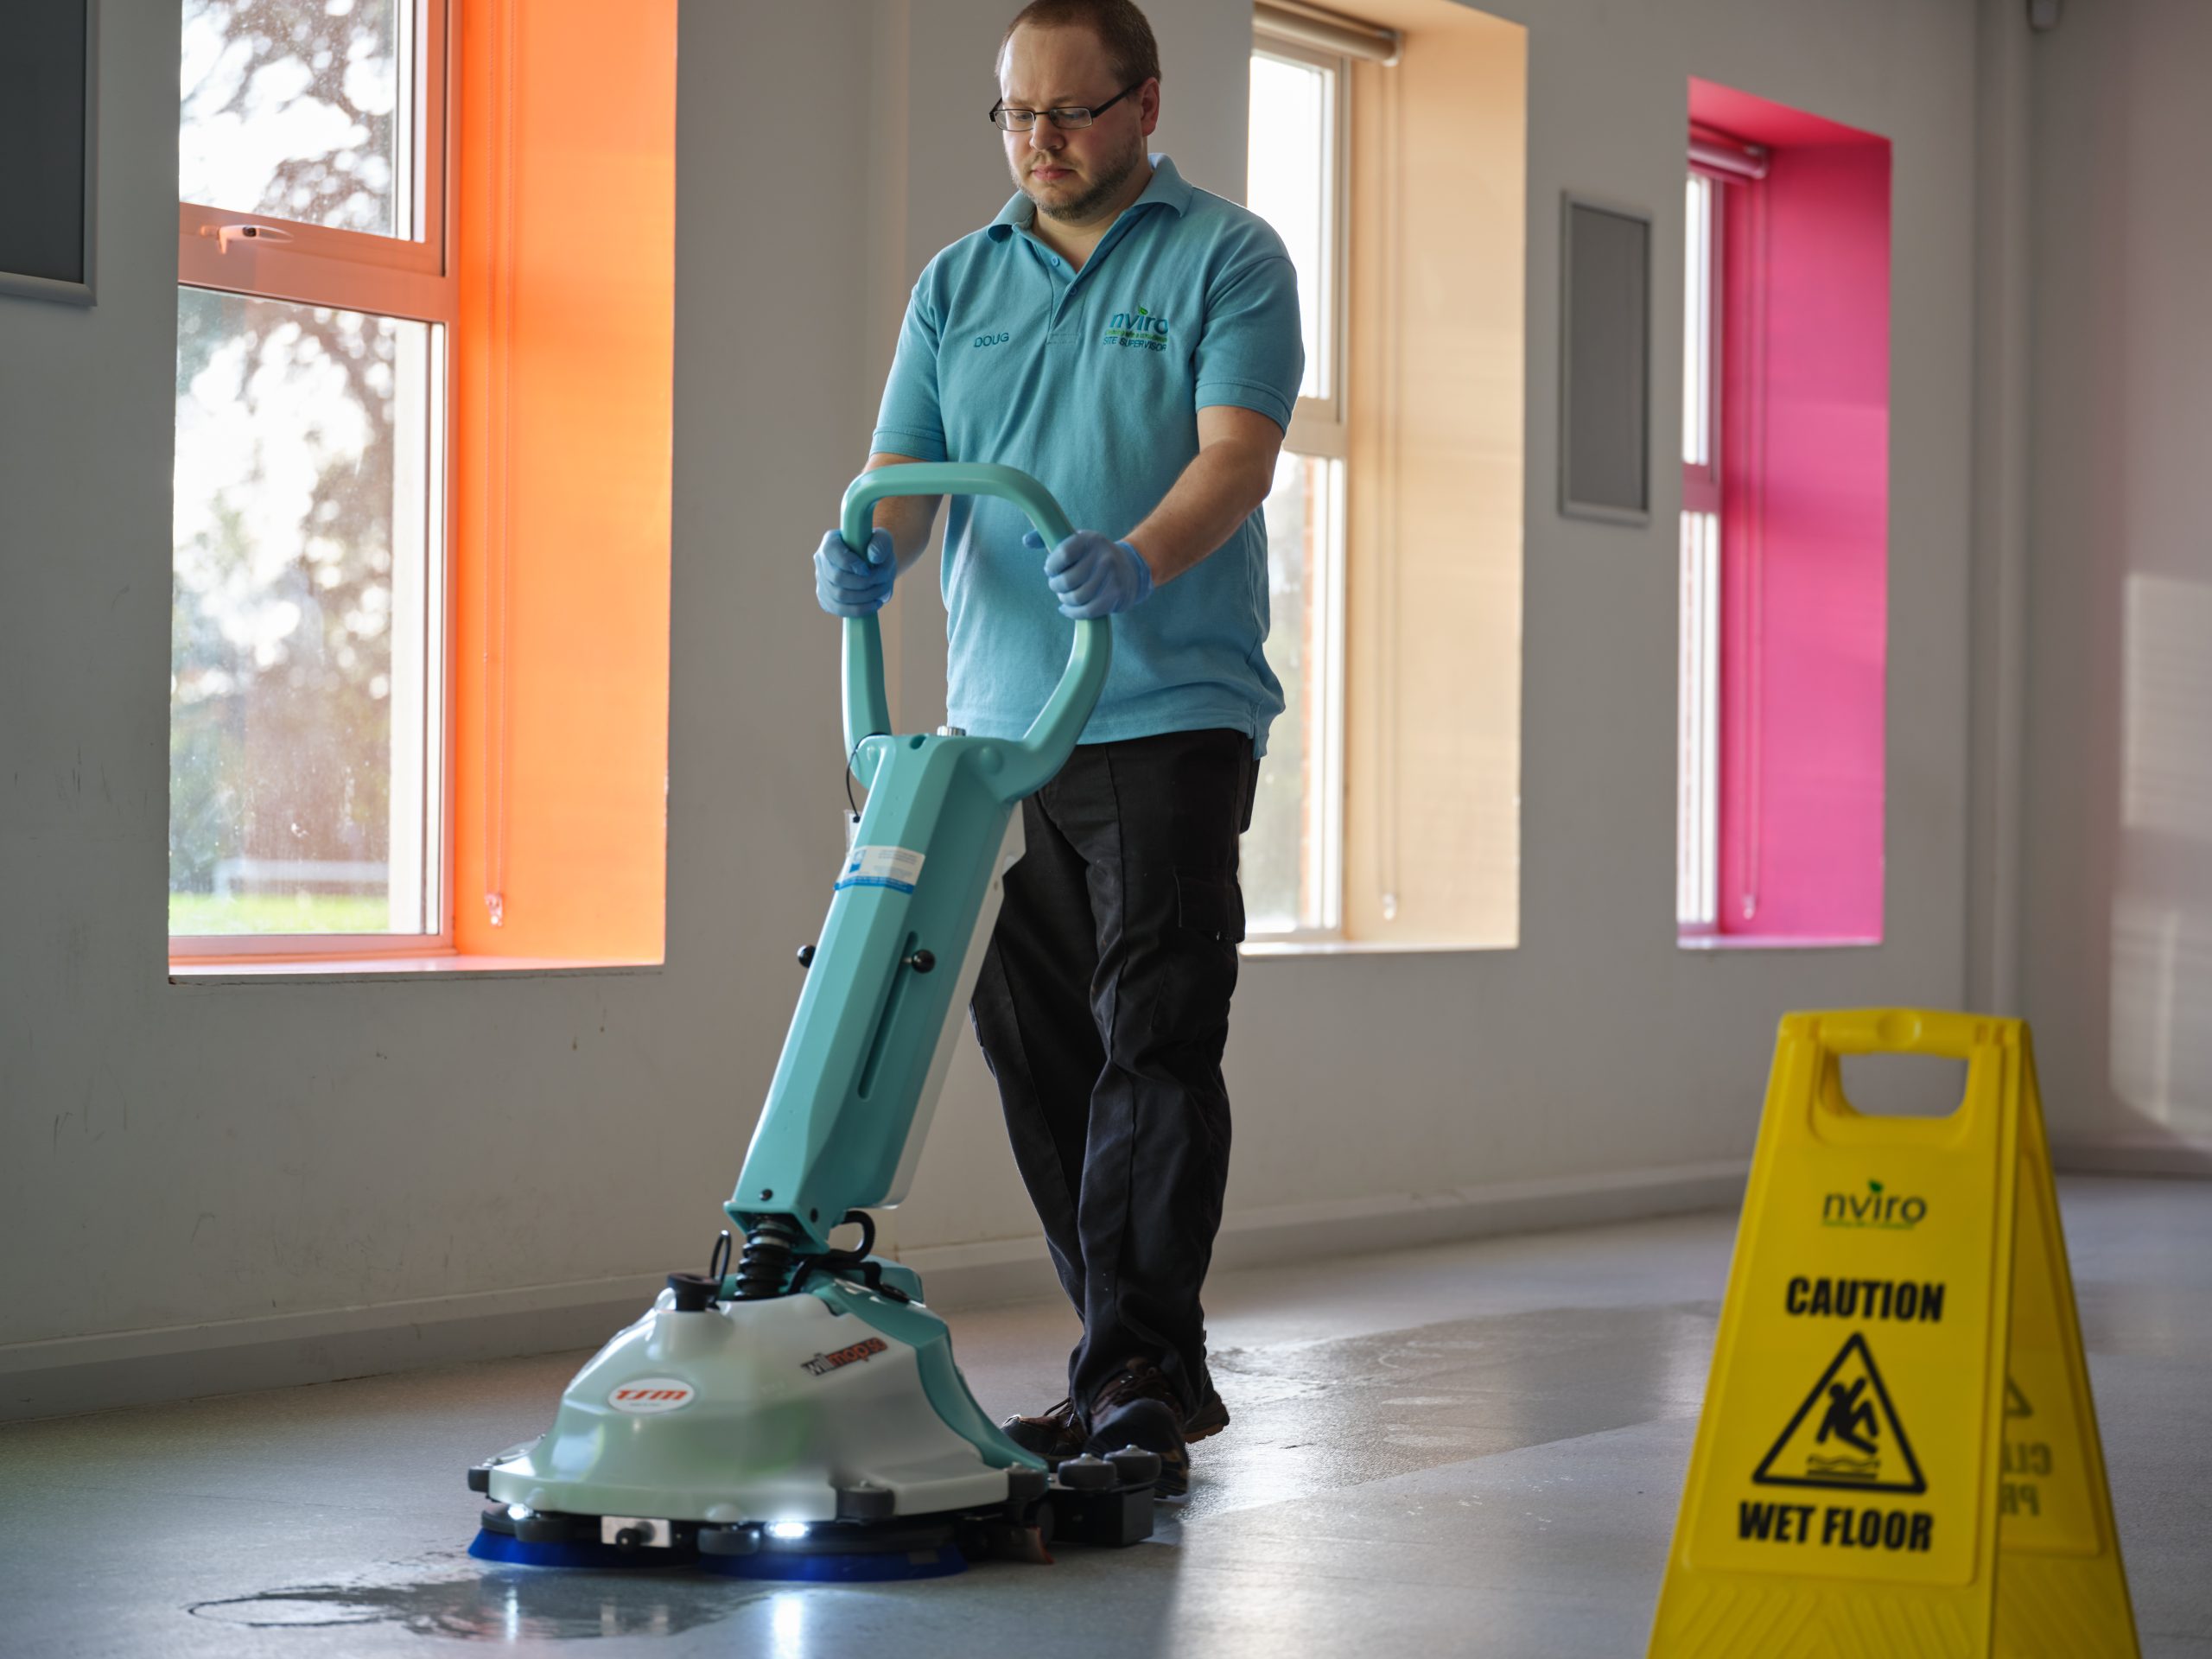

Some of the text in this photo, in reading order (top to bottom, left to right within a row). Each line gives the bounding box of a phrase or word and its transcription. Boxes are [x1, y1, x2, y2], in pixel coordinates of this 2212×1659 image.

[1109, 306, 1168, 334] nviro
[974, 333, 1009, 347] DOUG
[1103, 336, 1167, 352] SITE SUPERVISOR
[1822, 1179, 1928, 1224] nviro
[1785, 1276, 1945, 1323] CAUTION
[1738, 1501, 1934, 1552] WET FLOOR
